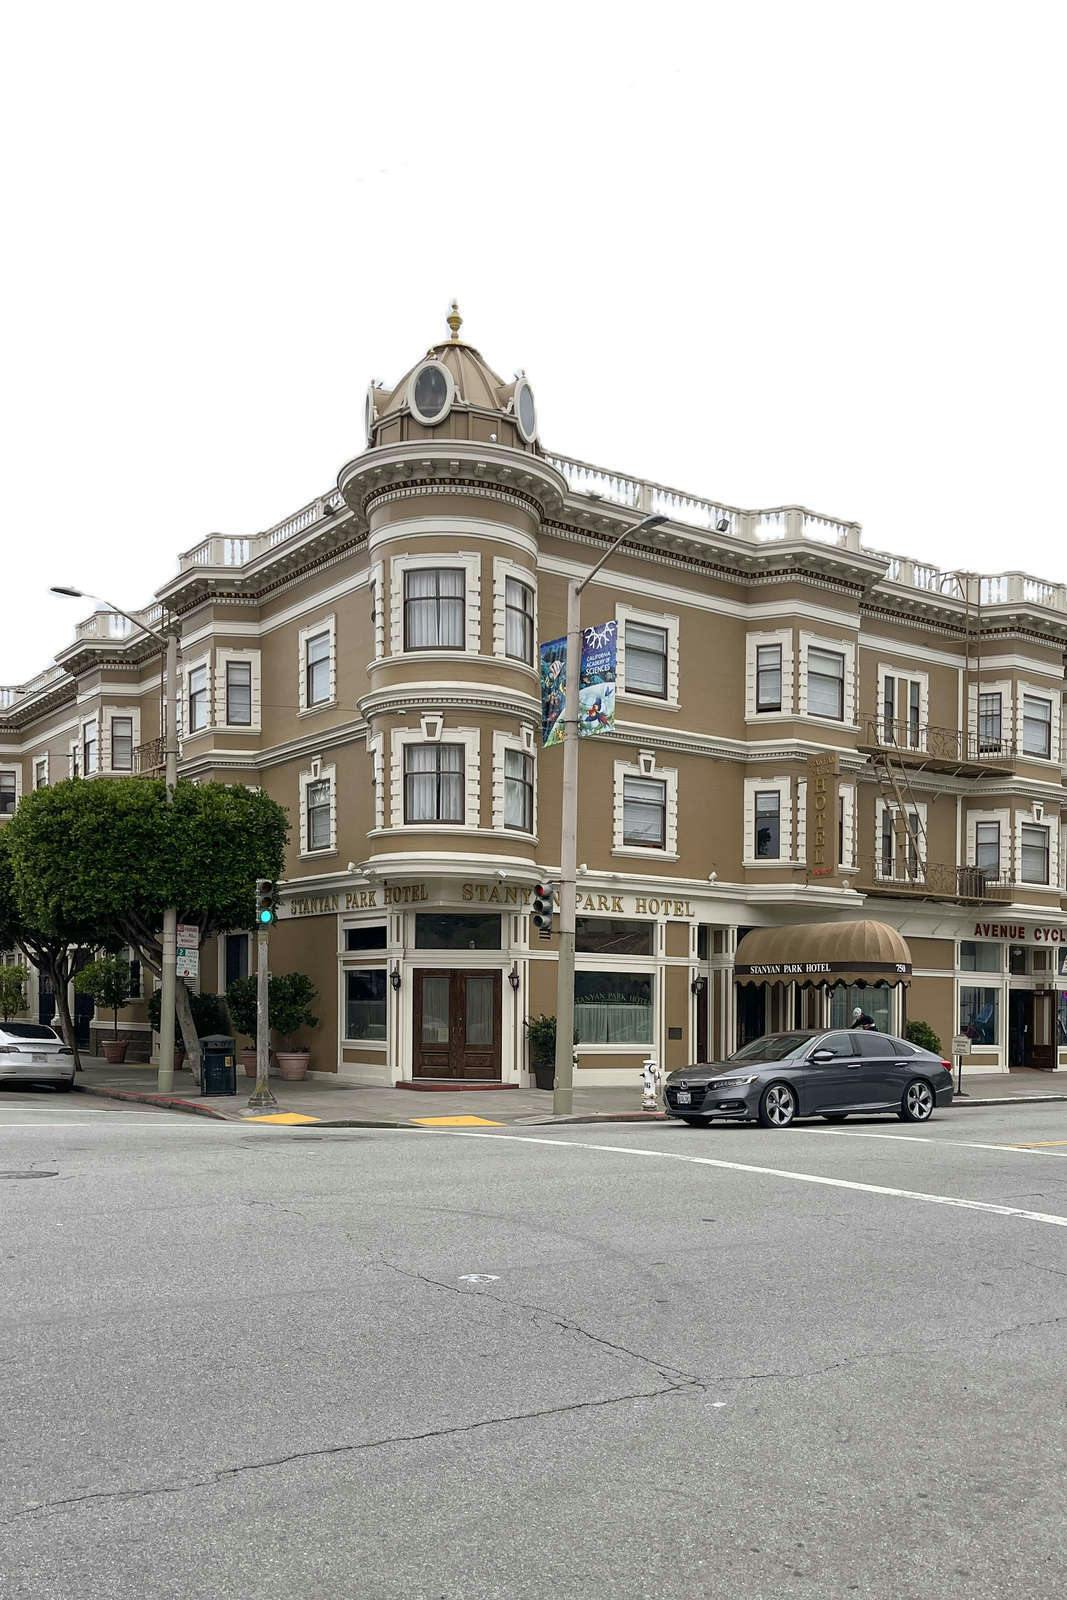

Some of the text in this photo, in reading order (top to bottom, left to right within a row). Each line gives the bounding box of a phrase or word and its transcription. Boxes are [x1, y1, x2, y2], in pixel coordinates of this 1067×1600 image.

[586, 663, 611, 675] SCIENCES
[815, 778, 826, 864] HOTEL
[289, 884, 429, 915] STANYAN PARK HOTEL
[462, 883, 695, 918] STANYN PARK HOTEL
[974, 923, 1025, 940] AVENUE
[750, 963, 831, 974] STANYAN PARK HOTEL
